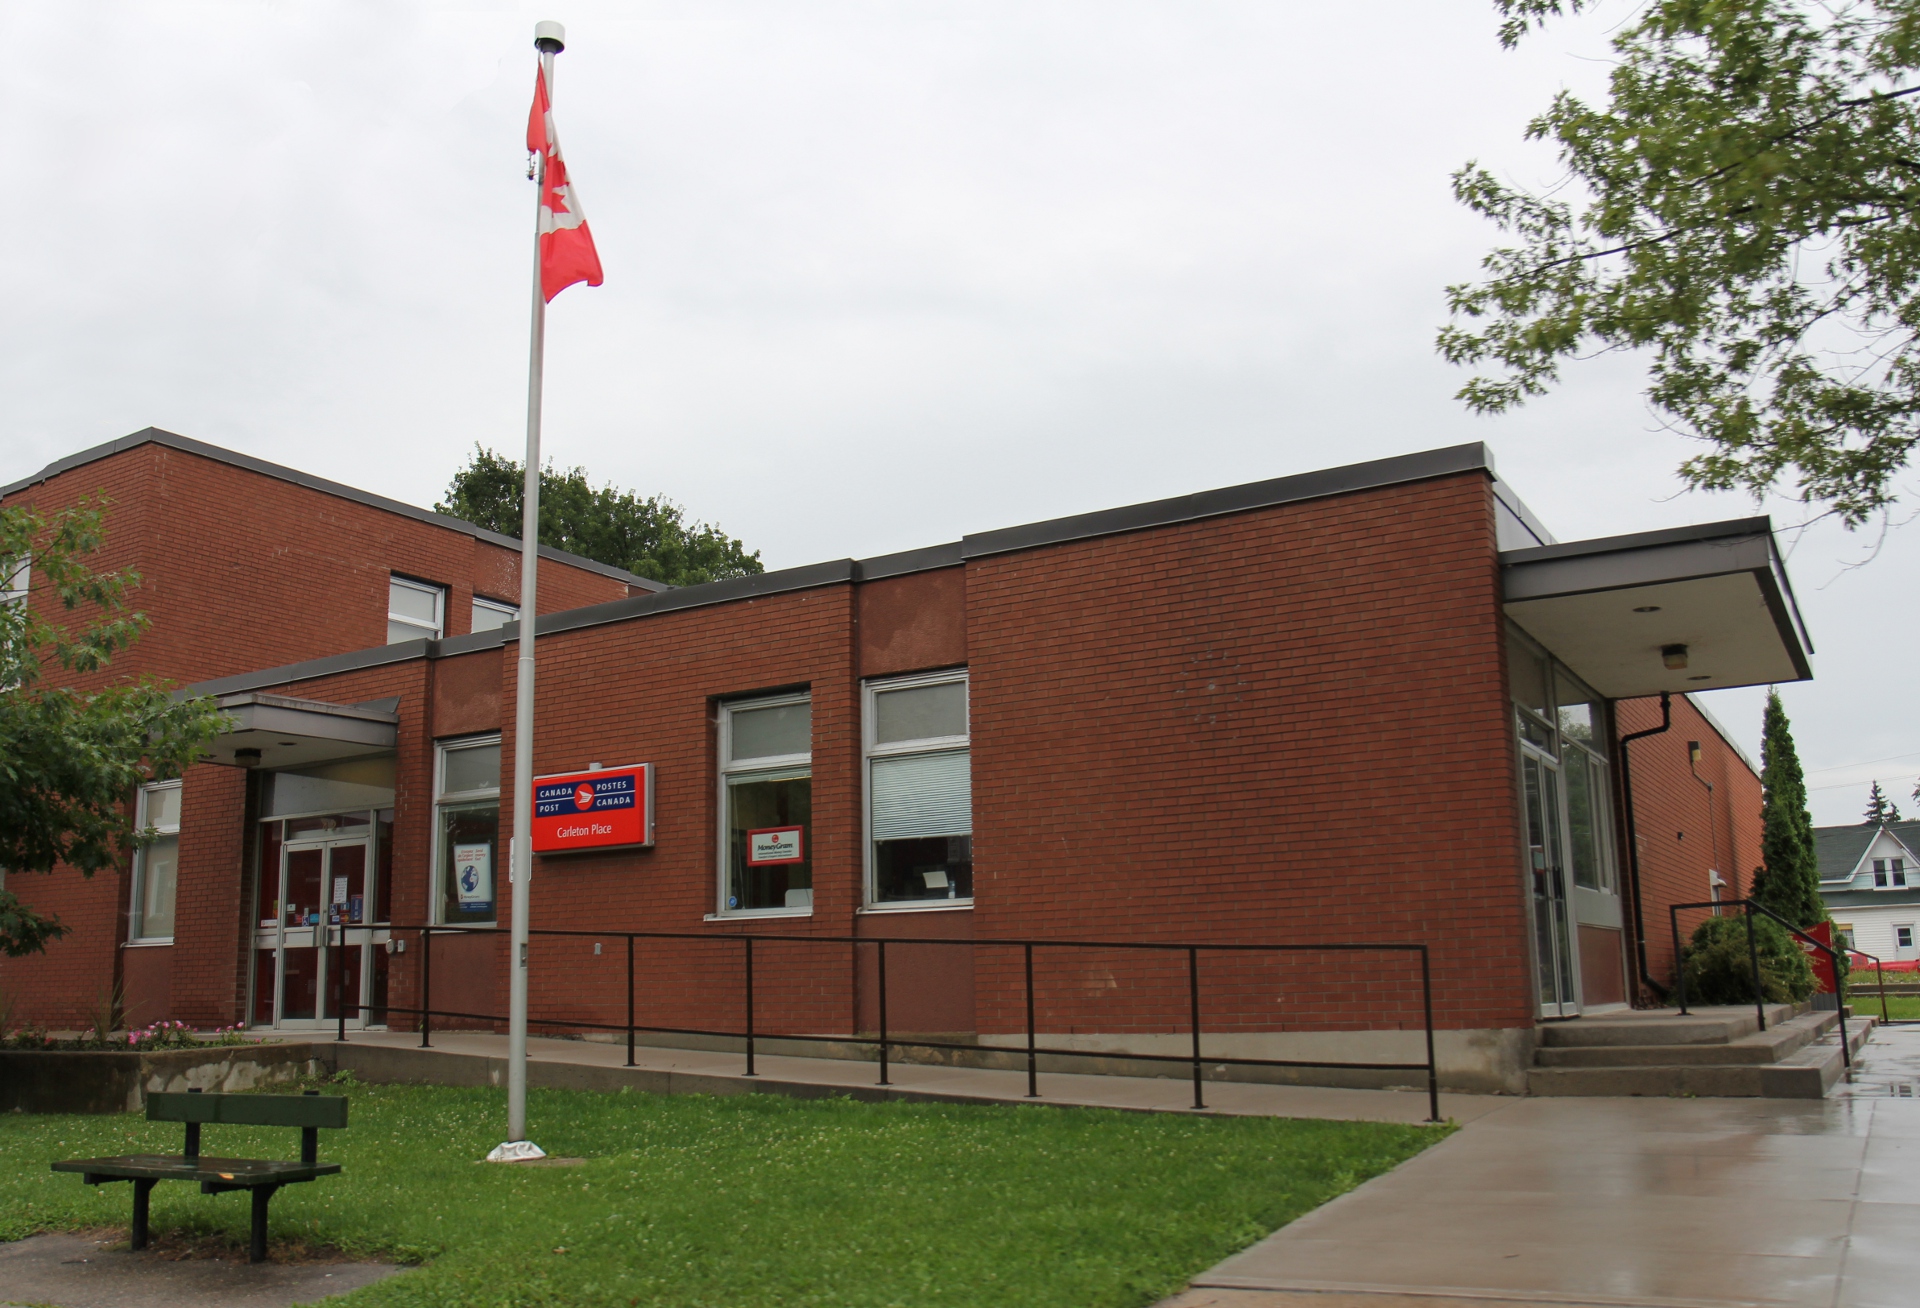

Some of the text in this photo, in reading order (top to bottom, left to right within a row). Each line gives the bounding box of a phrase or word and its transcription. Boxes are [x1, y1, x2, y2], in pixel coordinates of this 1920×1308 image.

[596, 781, 627, 791] POSTES
[539, 787, 573, 798] CANADA
[596, 796, 631, 807] CANADA
[539, 804, 559, 813] POST
[556, 823, 612, 838] Carleton Place
[757, 843, 793, 851] MoneyGram
